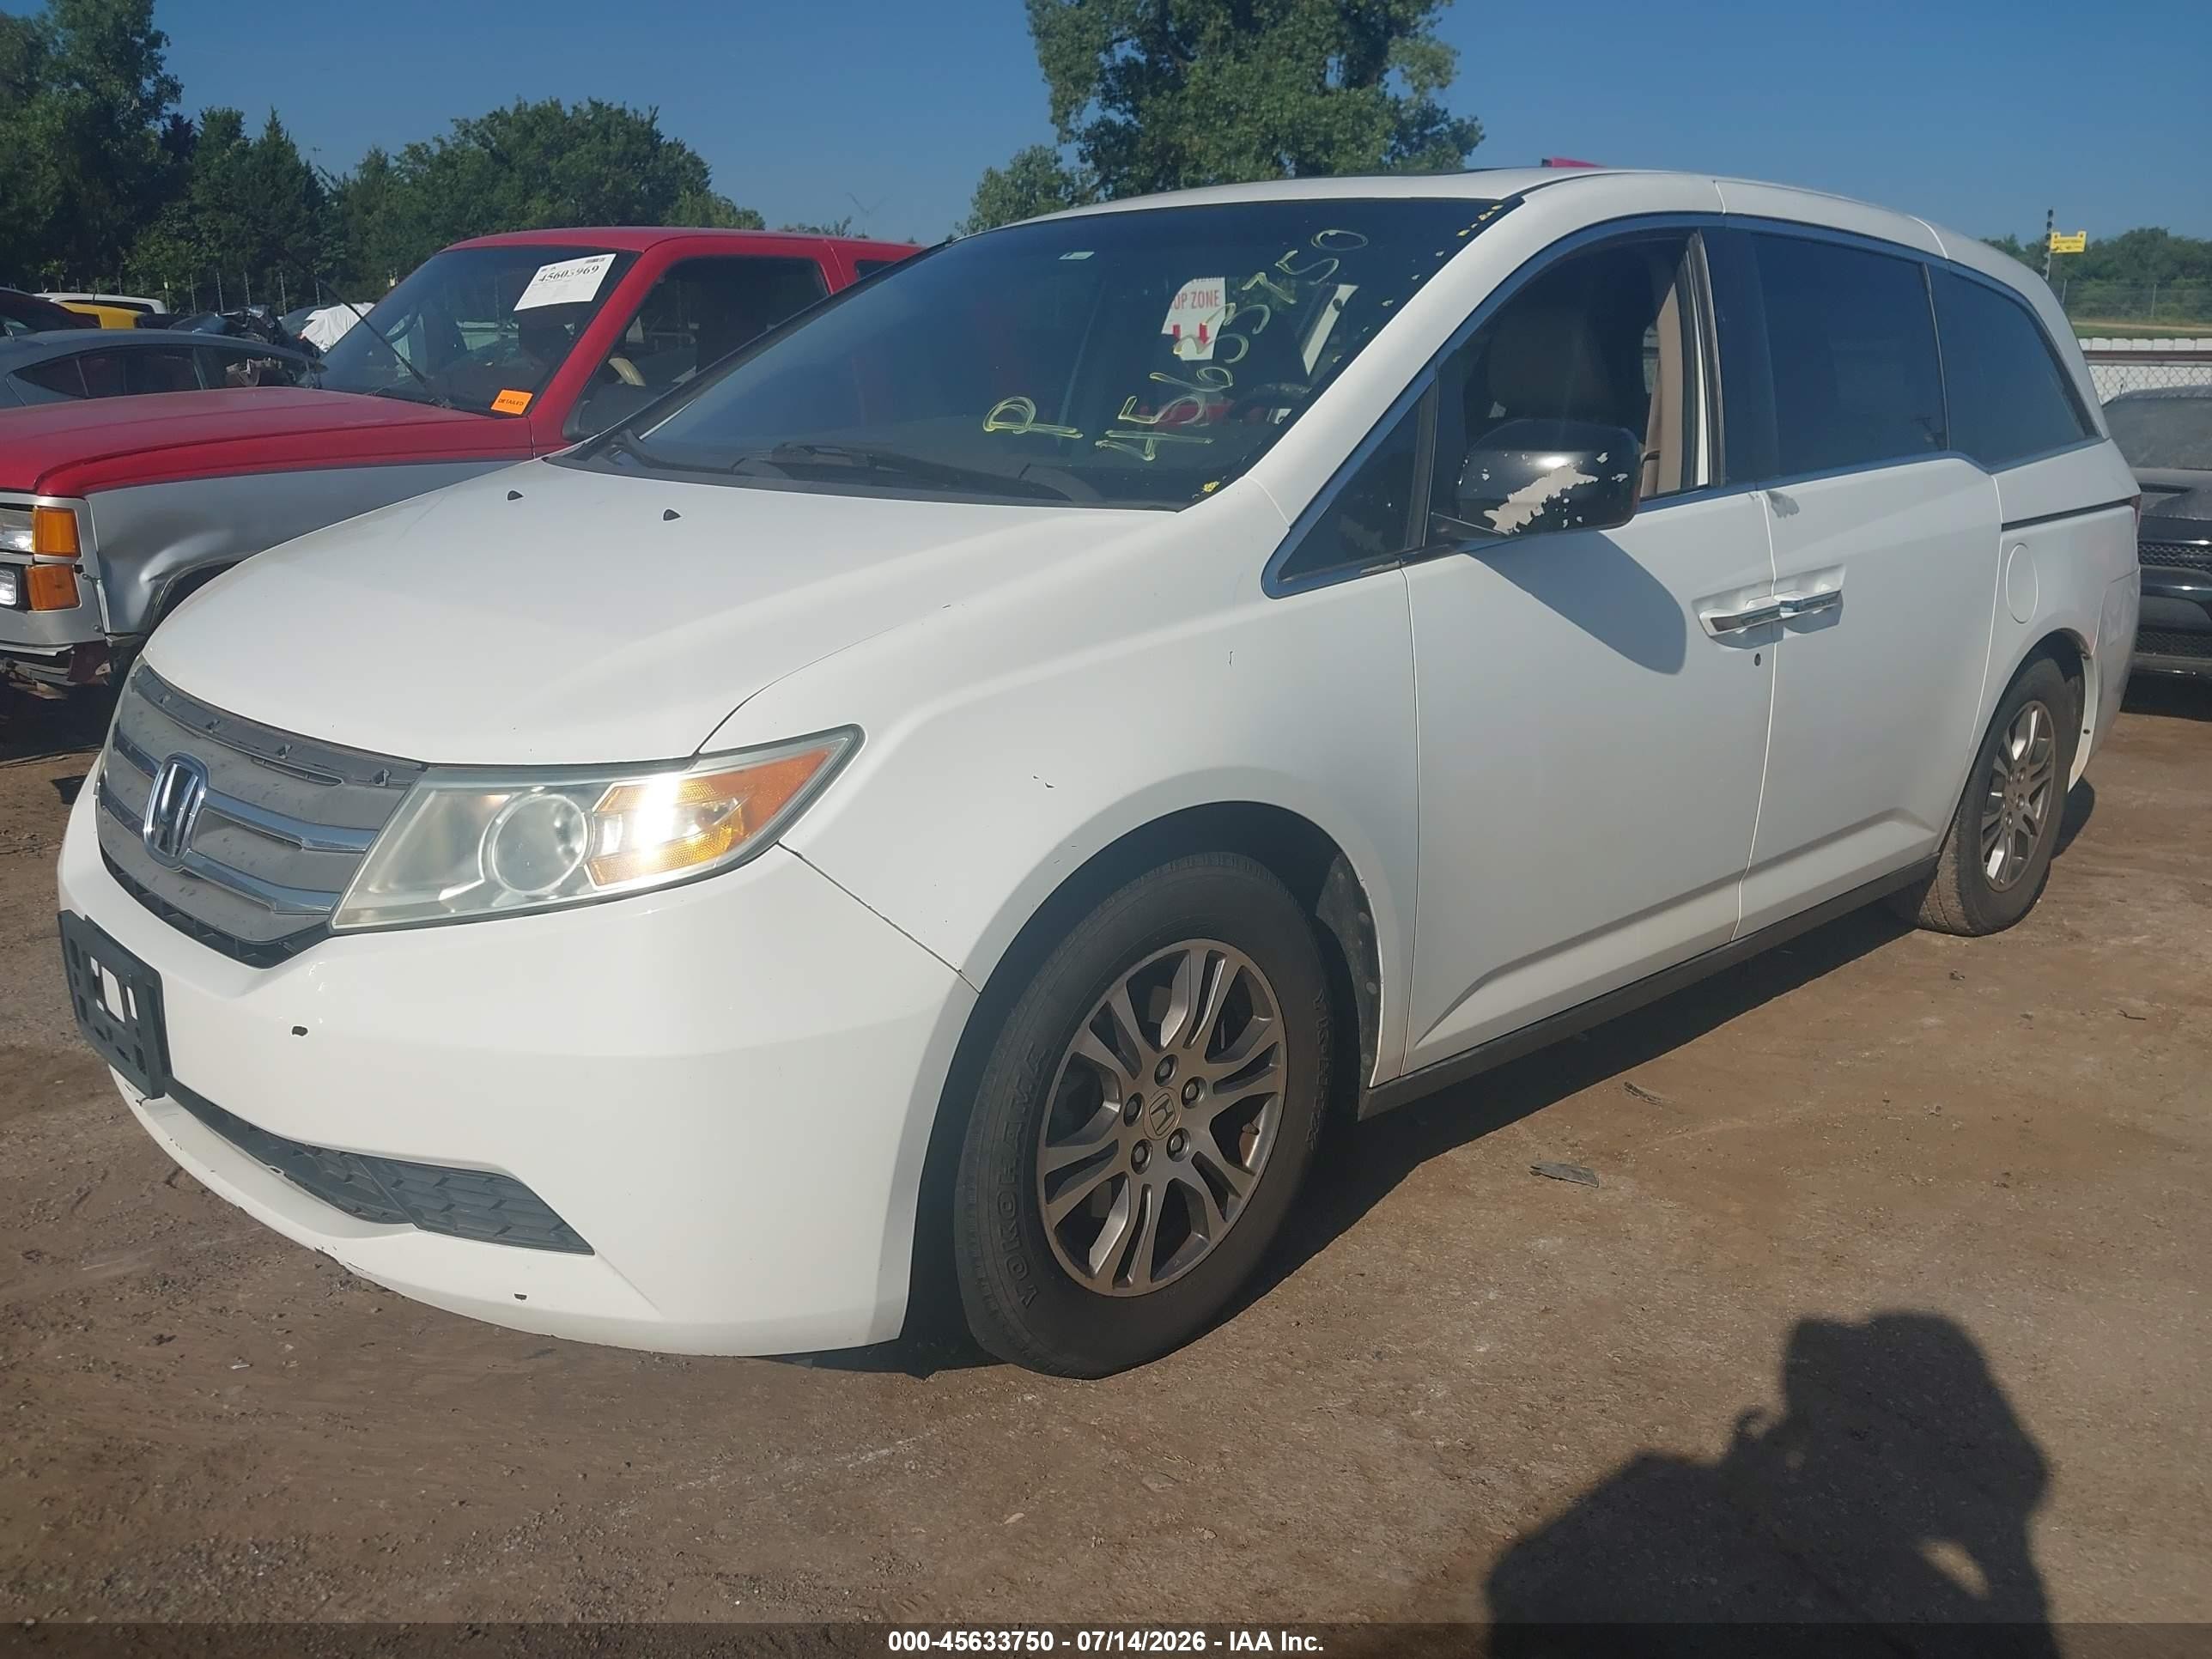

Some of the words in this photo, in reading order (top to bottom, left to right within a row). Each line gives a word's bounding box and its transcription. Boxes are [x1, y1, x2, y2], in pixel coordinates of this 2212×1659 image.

[1095, 229, 1369, 461] 45633750
[1191, 289, 1221, 309] ZONE
[996, 1040, 1048, 1308] YOKOHAMA
